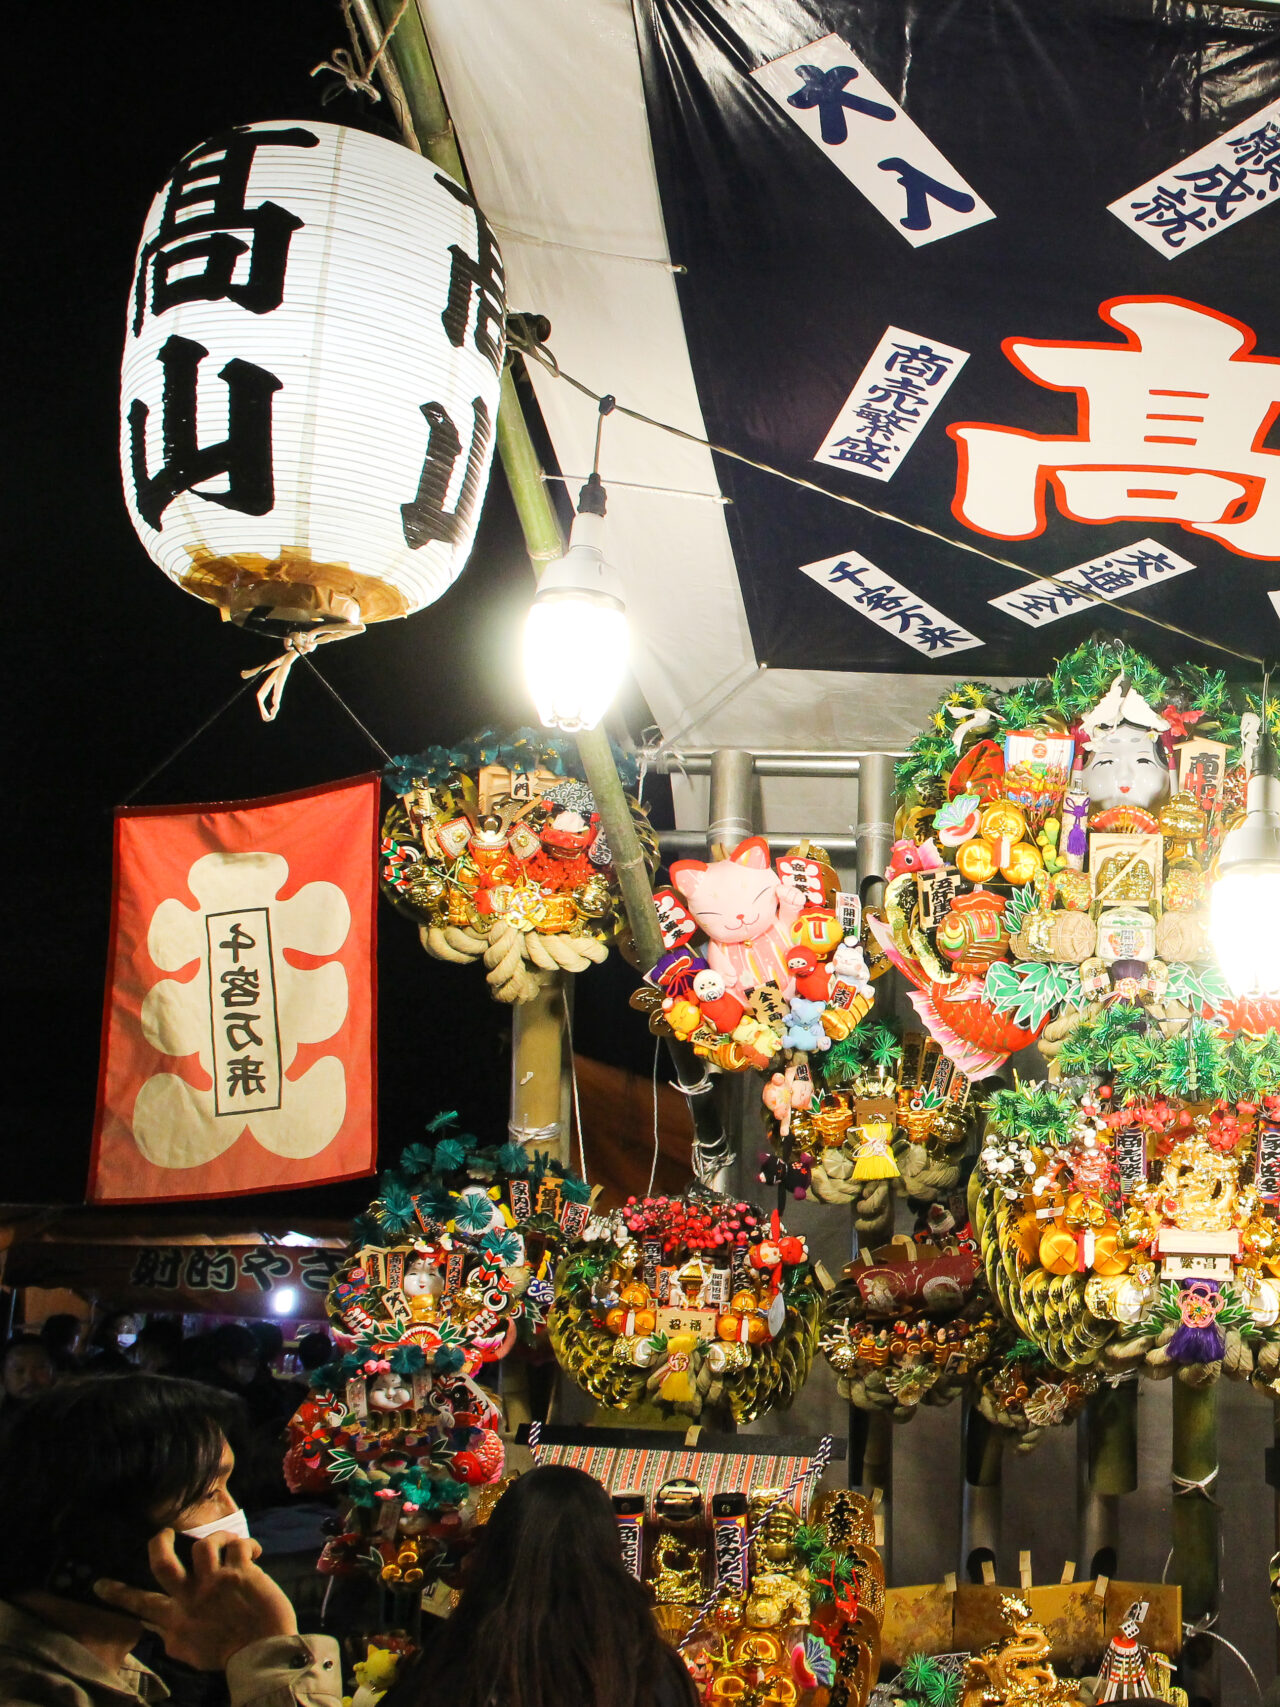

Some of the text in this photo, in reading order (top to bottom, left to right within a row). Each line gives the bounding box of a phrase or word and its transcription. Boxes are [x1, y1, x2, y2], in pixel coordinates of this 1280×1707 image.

[787, 64, 975, 230] 大入
[830, 344, 954, 473] 商売繁盛
[827, 559, 970, 651] 千客万来
[1006, 549, 1178, 619] 交通安全
